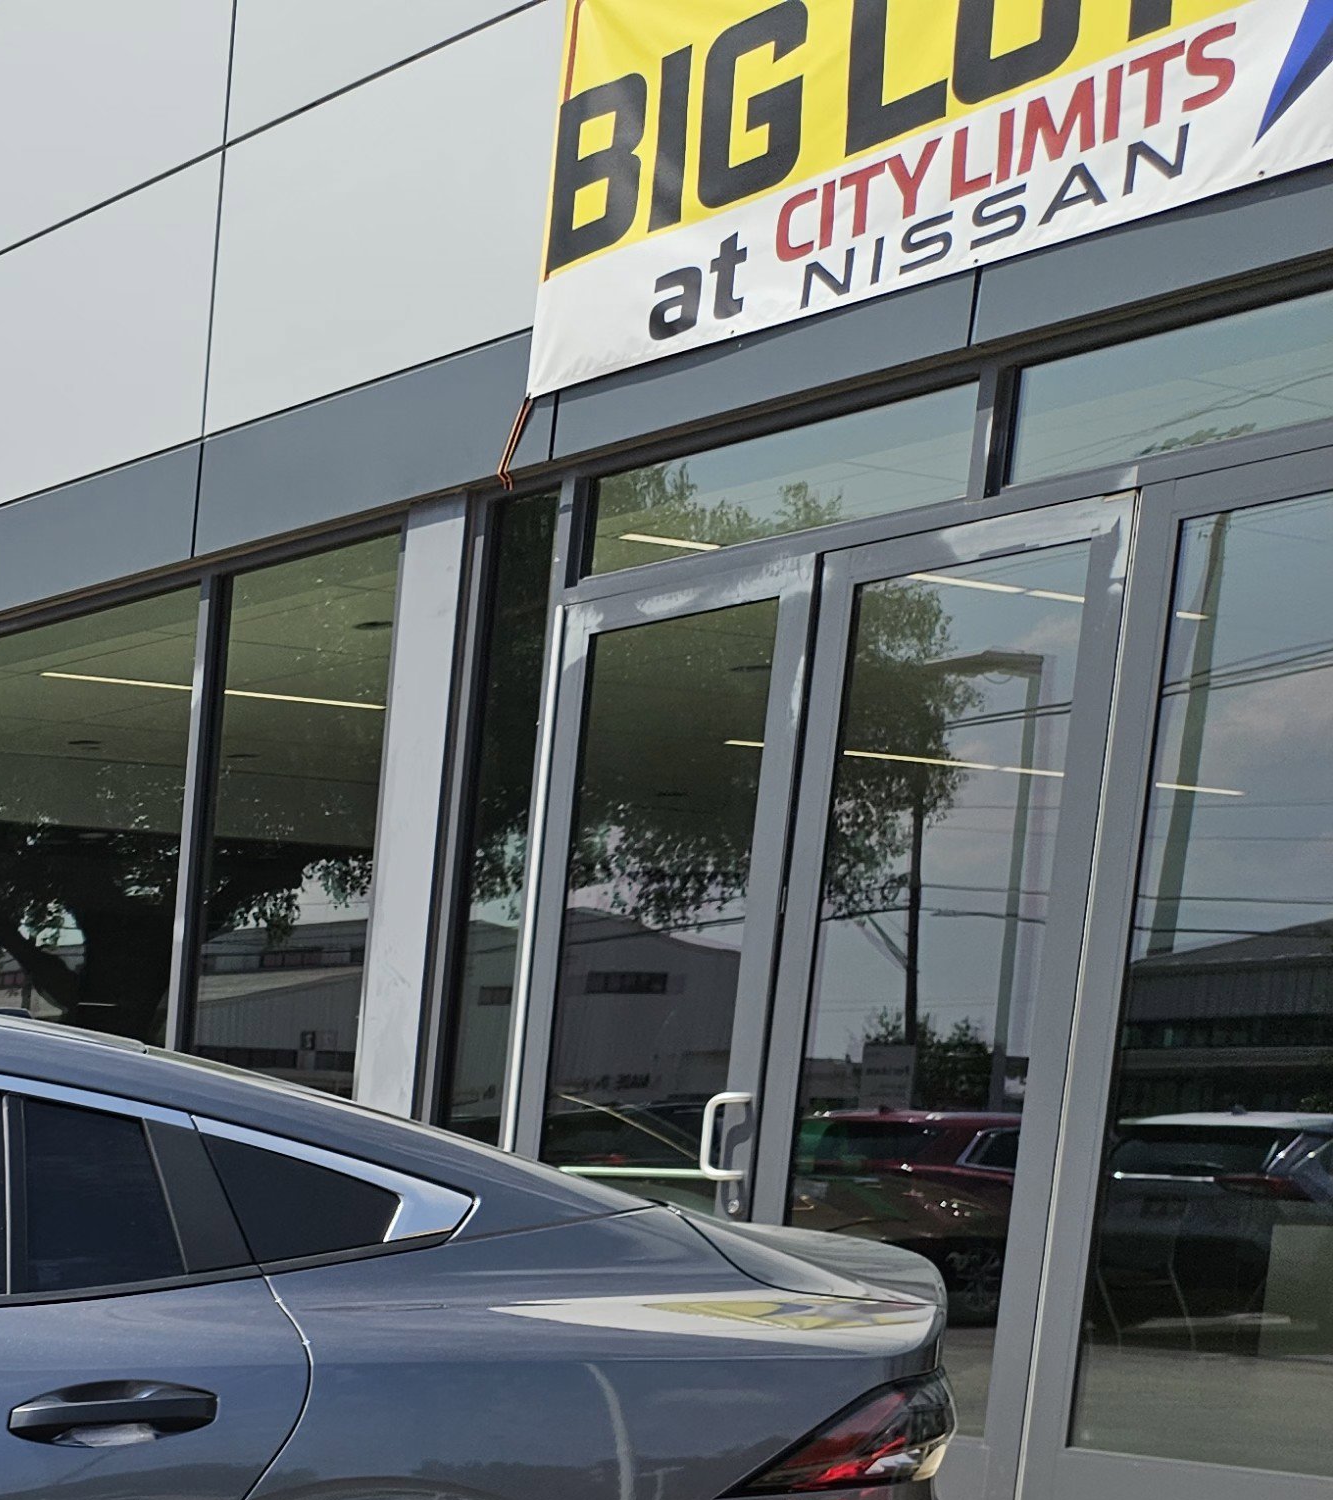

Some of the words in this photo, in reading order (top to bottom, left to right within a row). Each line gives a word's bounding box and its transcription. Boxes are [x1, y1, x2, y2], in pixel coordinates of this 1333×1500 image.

[549, 0, 808, 272] BIG
[776, 137, 942, 262] CITY
[950, 22, 1237, 200] LIMITS
[800, 123, 1190, 309] NISSAN
[649, 231, 747, 341] at
